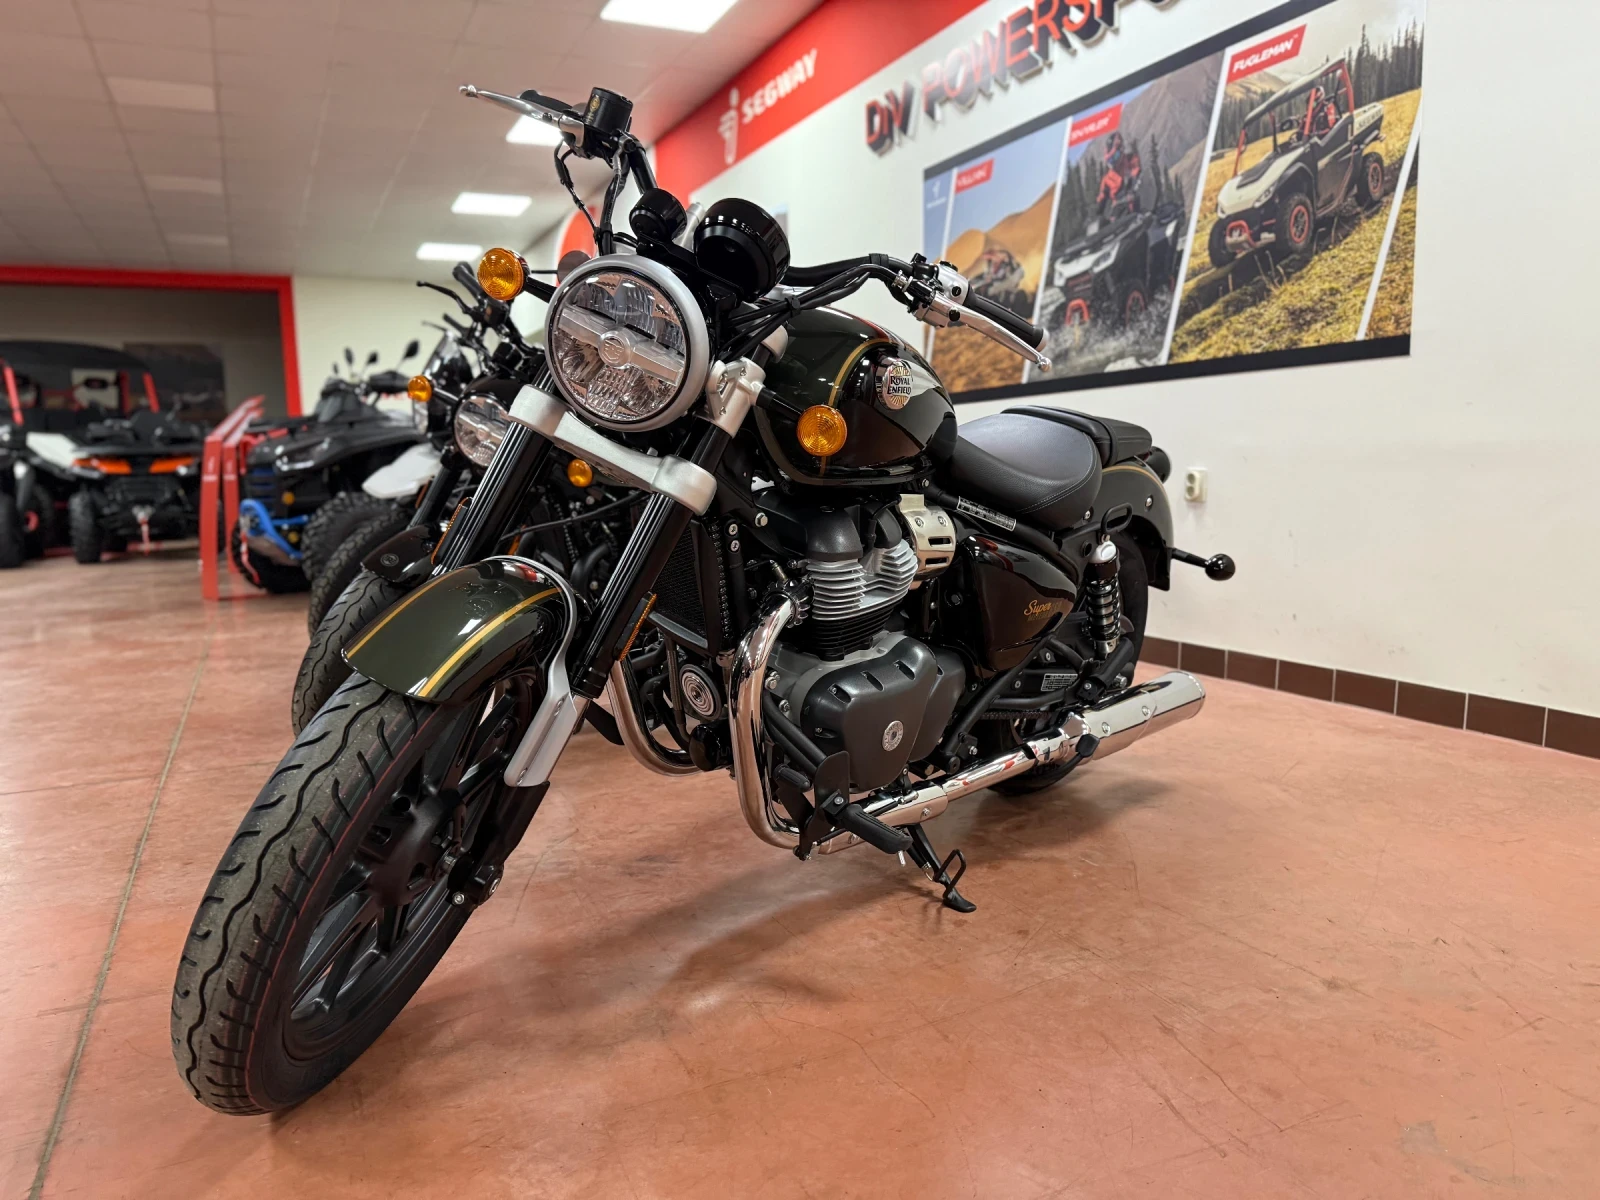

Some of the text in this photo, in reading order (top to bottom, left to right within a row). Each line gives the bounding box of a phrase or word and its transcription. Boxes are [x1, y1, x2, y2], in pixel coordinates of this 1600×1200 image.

[921, 0, 1122, 120] POWERS
[1232, 38, 1294, 74] FUGLEMAN
[741, 48, 818, 125] SEGWAY
[887, 386, 912, 395] ENFIELD
[890, 375, 911, 386] ROYAL
[1023, 599, 1053, 617] Super
